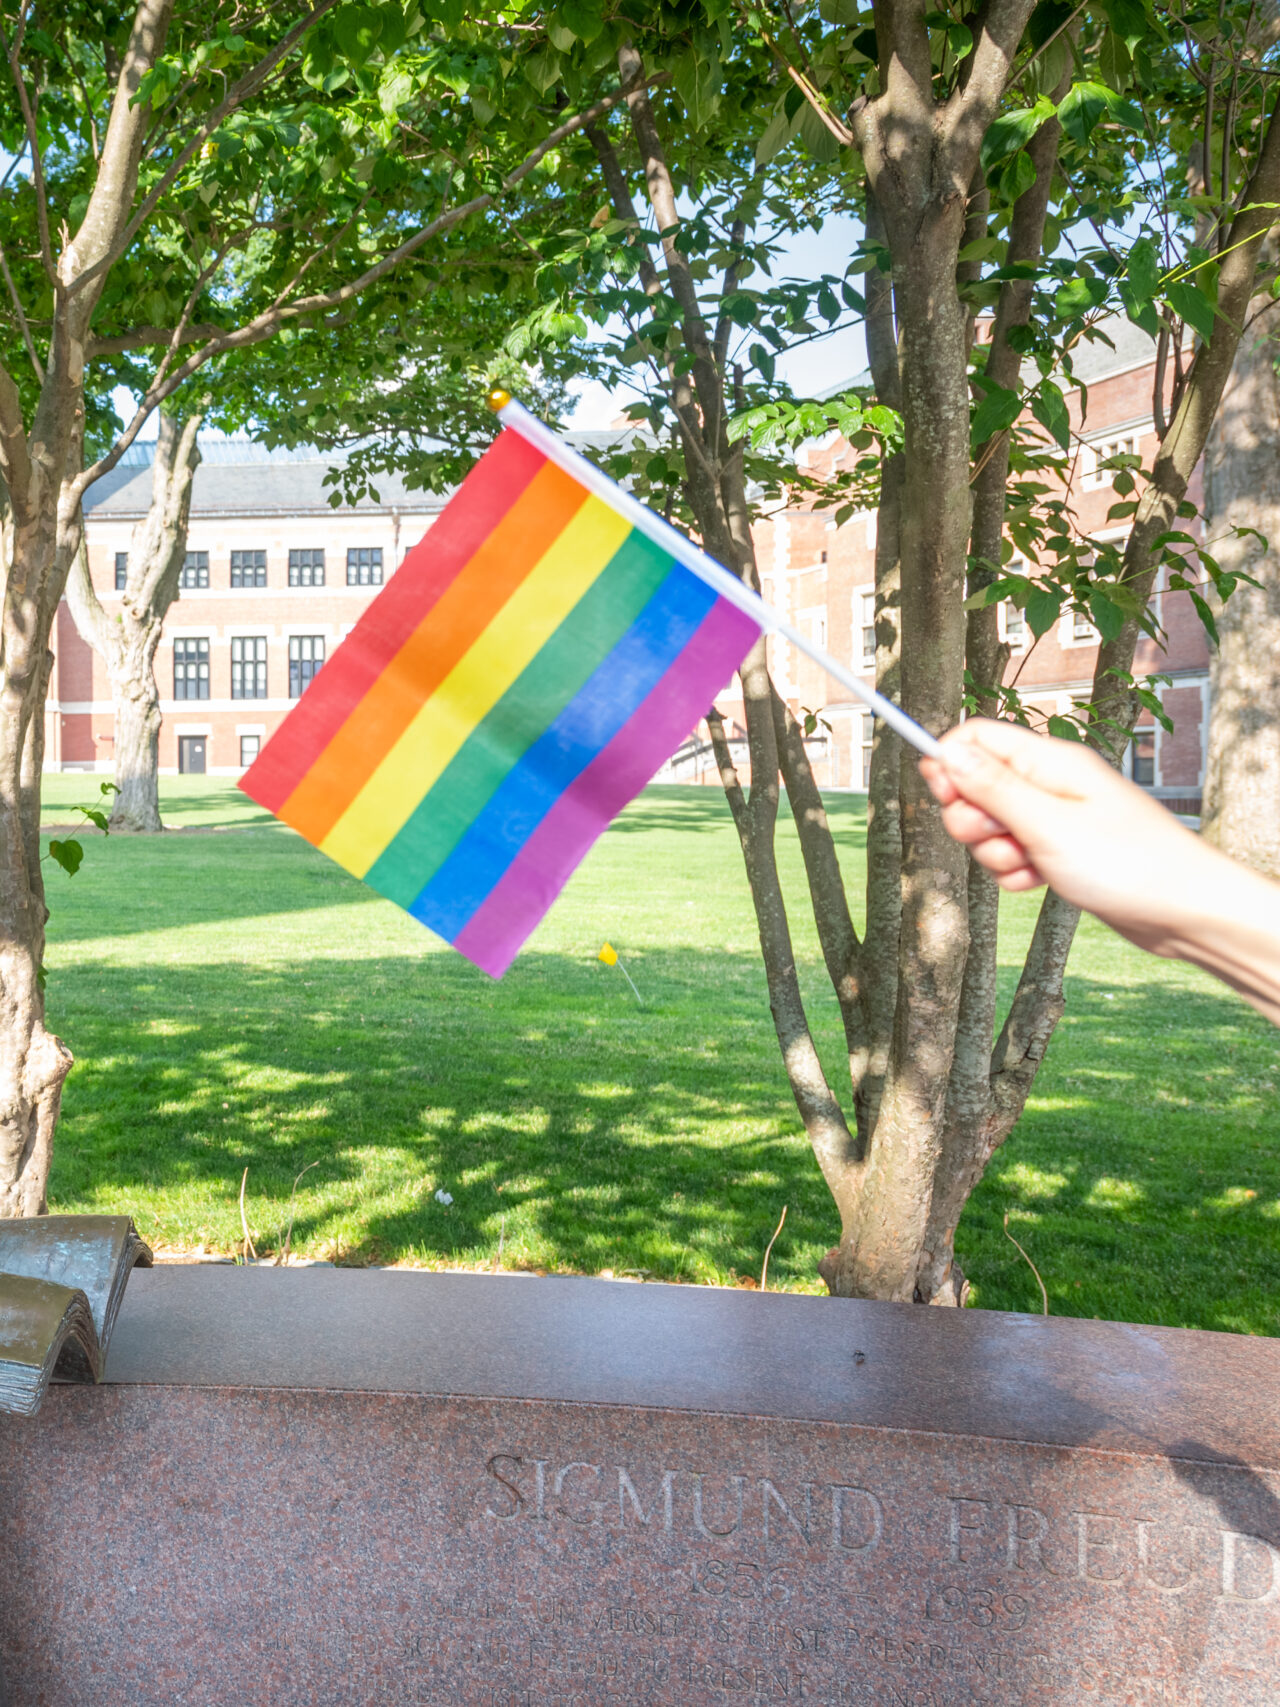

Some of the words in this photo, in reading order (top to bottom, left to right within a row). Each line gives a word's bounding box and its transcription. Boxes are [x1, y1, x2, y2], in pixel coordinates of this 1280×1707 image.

[484, 1452, 886, 1554] SIGMUND
[944, 1494, 1280, 1602] FREUD
[688, 1558, 798, 1605] 1856
[922, 1584, 1030, 1632] 1939
[748, 1620, 826, 1652] FIRST
[687, 1660, 810, 1699] PRESENT
